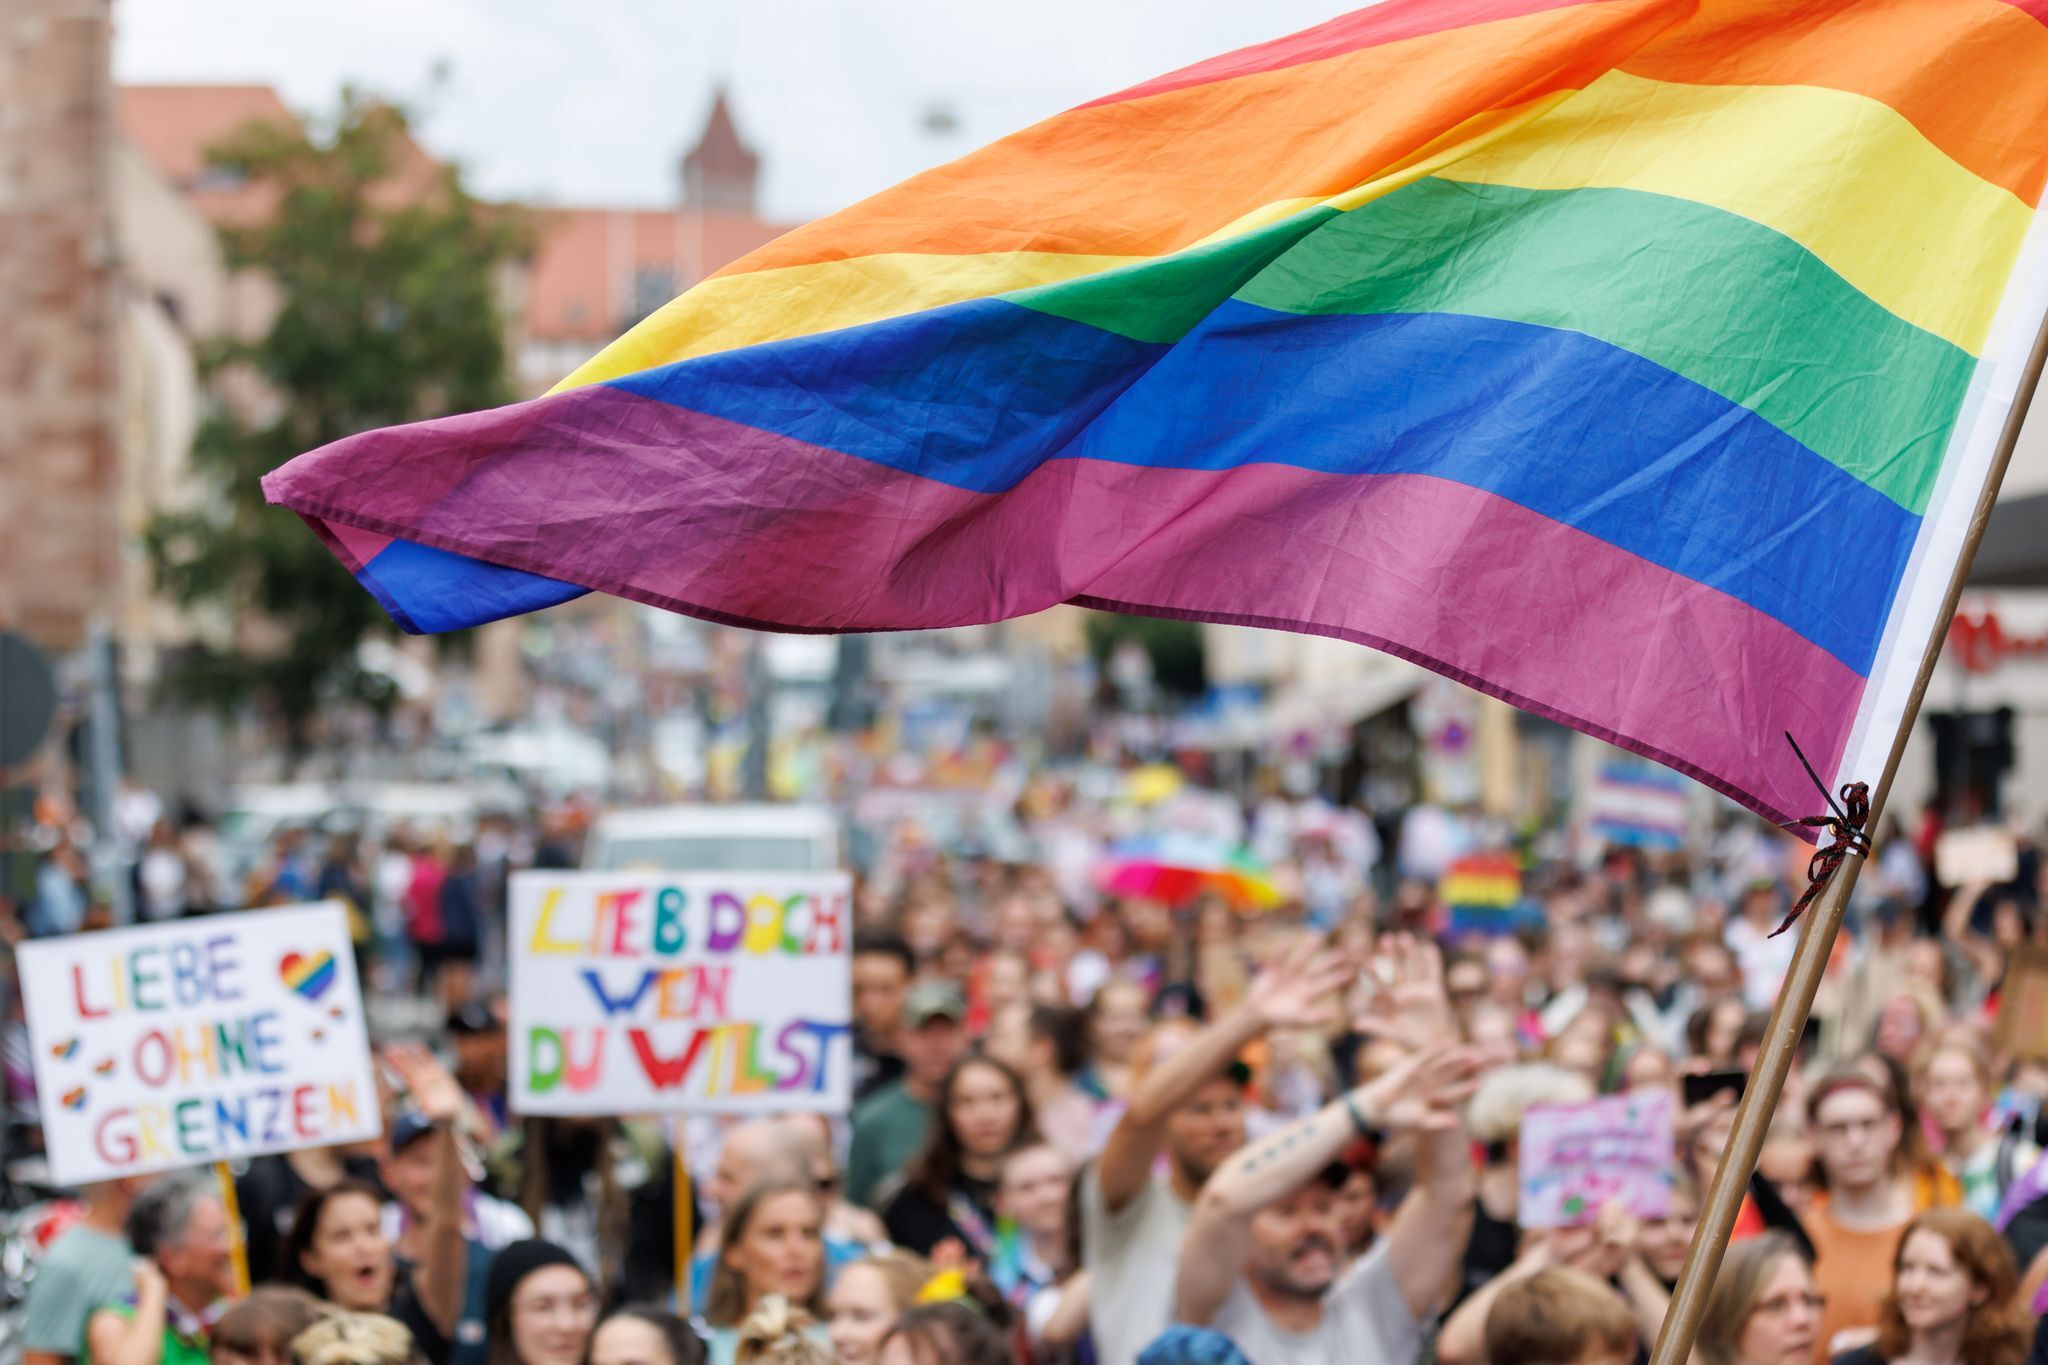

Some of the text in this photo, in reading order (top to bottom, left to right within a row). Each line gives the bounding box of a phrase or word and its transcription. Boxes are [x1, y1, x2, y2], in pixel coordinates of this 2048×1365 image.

[530, 887, 848, 957] LIEB DOCH
[71, 936, 243, 1019] LIEBE
[580, 964, 733, 1018] WEN
[133, 1011, 285, 1088] OHNE
[528, 1025, 607, 1093] DU
[94, 1081, 360, 1166] GRENZEN
